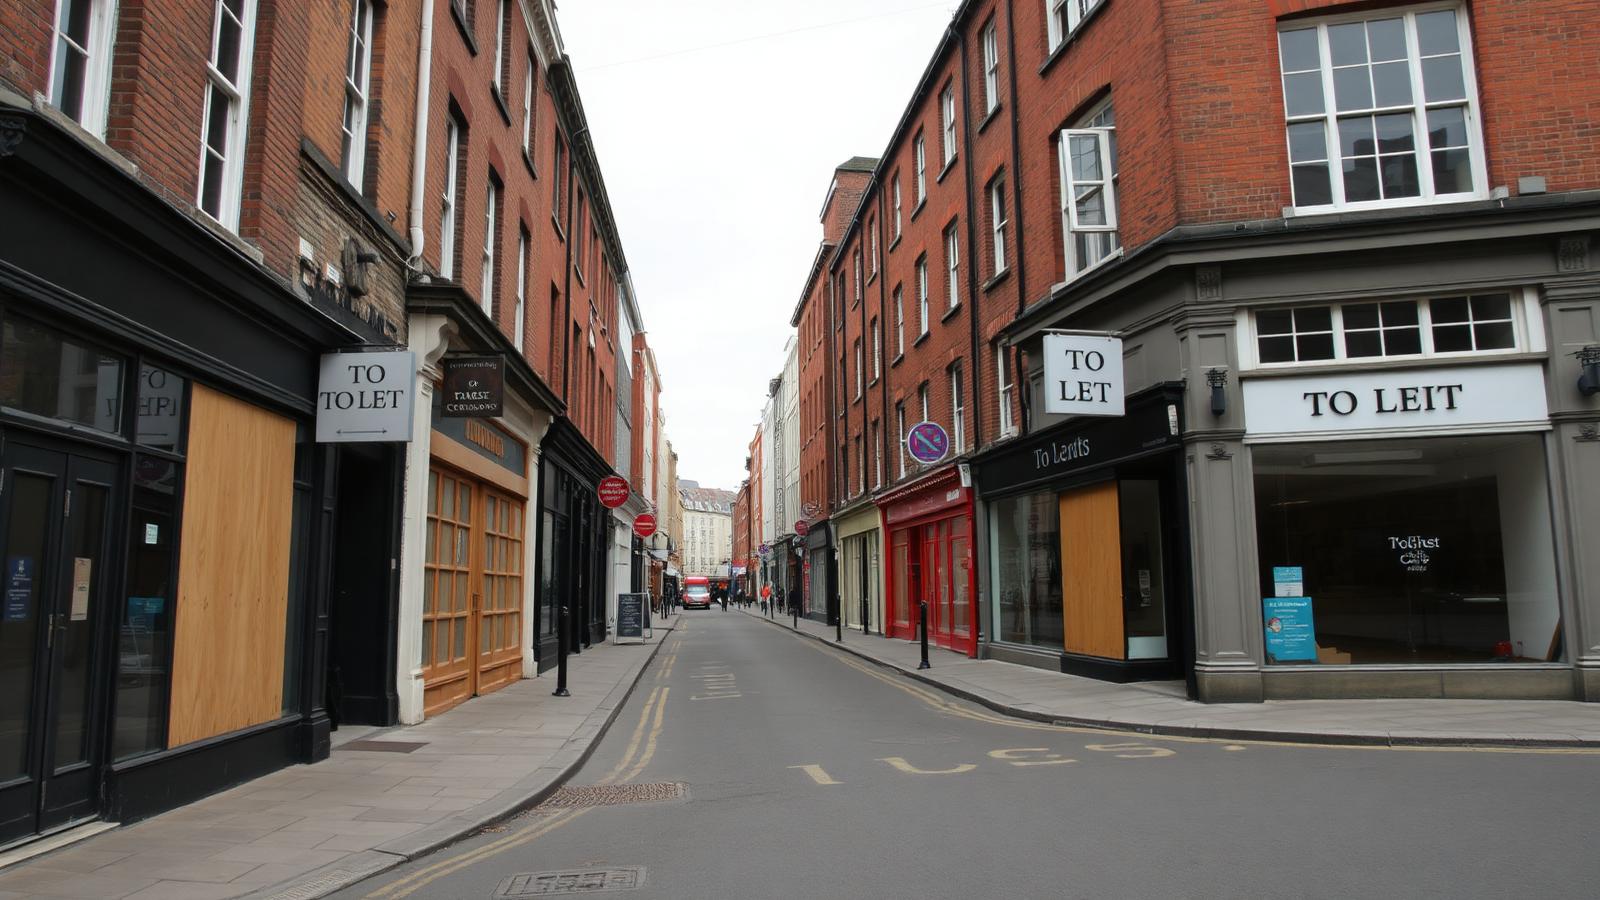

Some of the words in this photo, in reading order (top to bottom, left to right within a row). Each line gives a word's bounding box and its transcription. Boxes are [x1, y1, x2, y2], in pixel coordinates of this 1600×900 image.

[1065, 349, 1105, 372] TO
[347, 364, 386, 384] TO
[1059, 380, 1112, 403] LET
[1303, 390, 1358, 417] TO
[1373, 383, 1463, 414] LEIT
[1034, 448, 1050, 469] To
